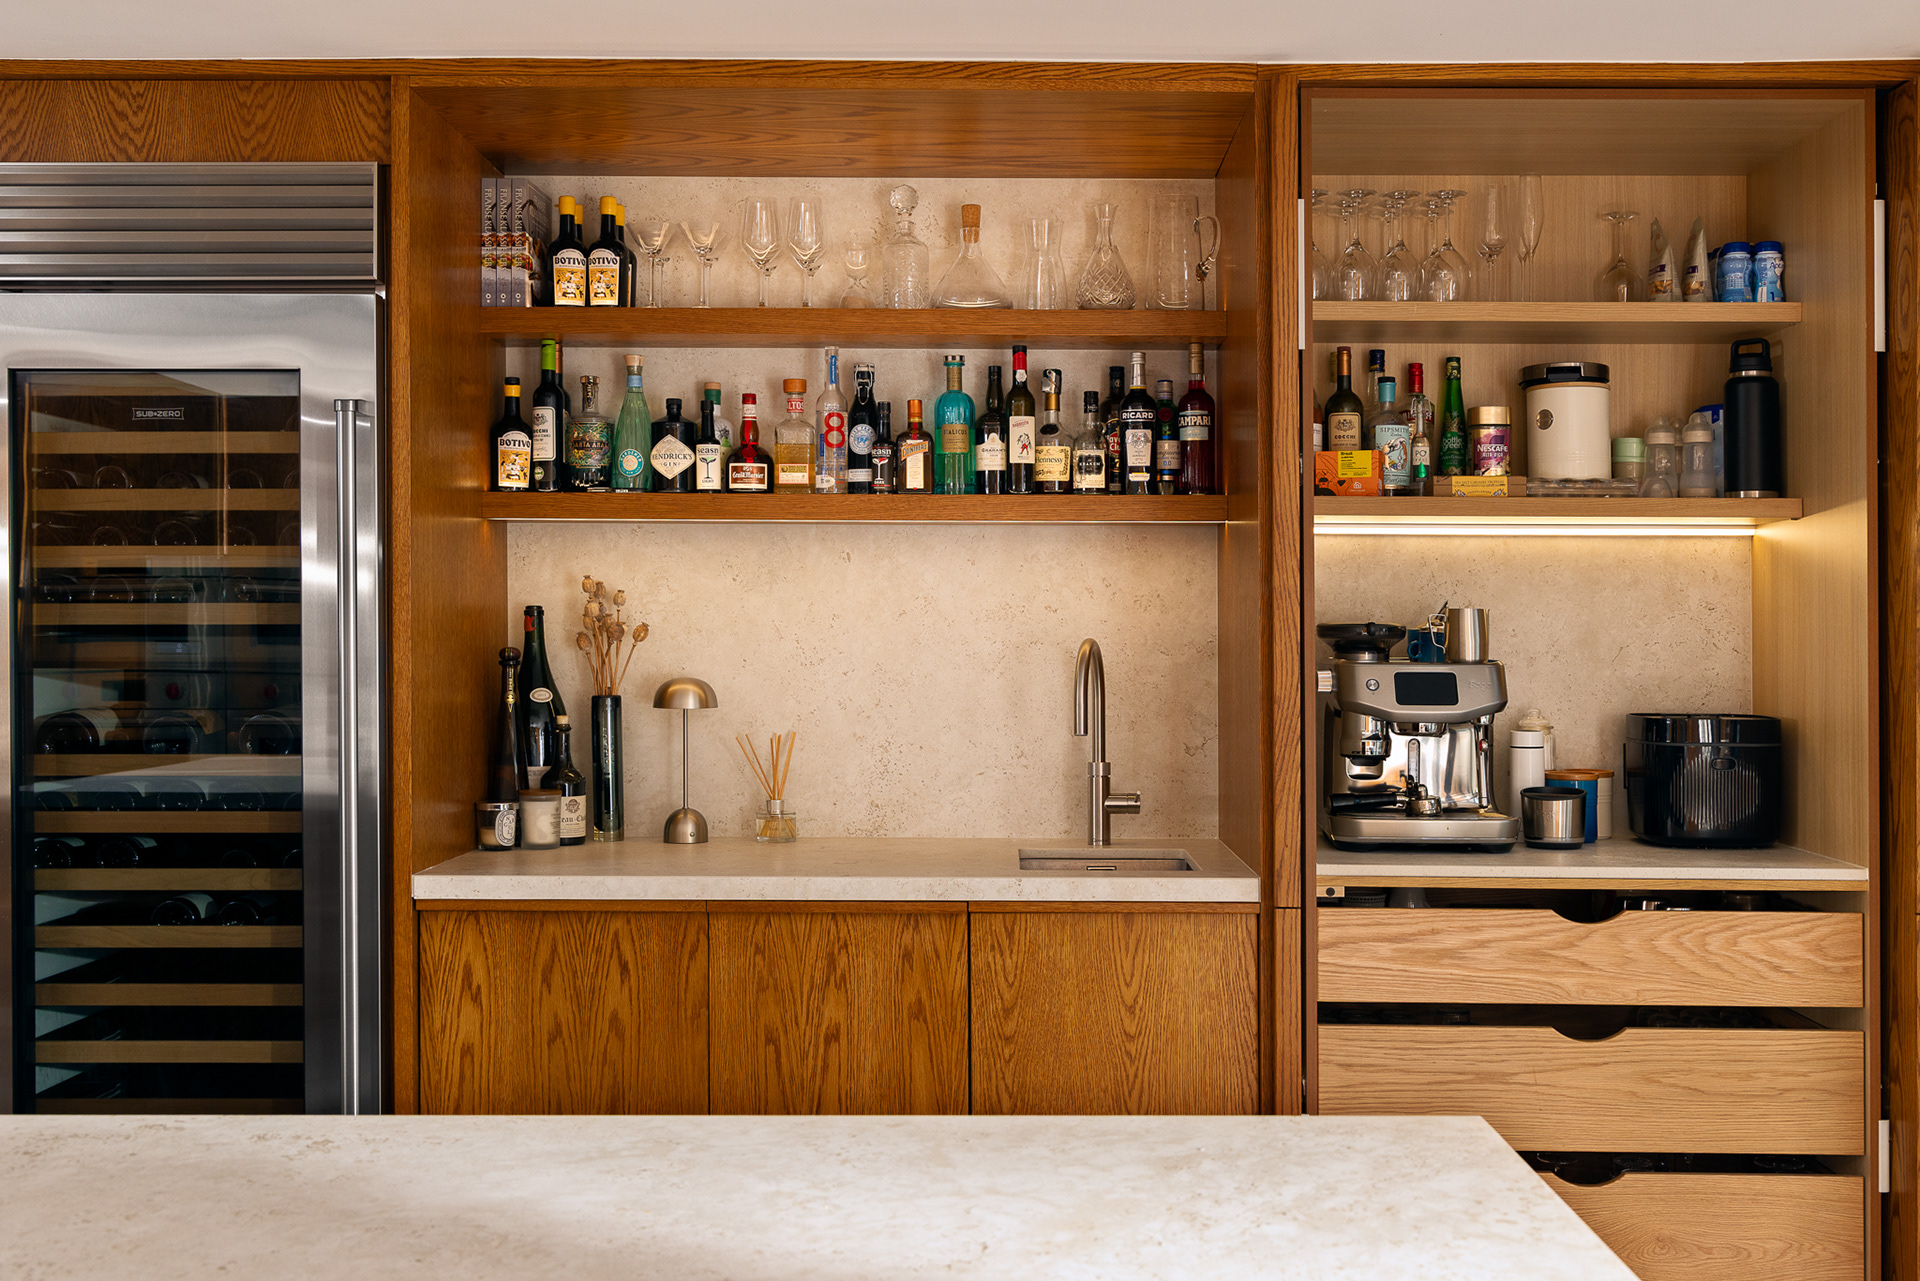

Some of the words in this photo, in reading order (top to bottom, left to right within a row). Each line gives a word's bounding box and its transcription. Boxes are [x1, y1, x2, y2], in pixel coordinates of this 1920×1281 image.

[555, 257, 586, 266] BOTIVO
[589, 257, 618, 265] BOTIVO
[824, 412, 845, 448] 8
[500, 439, 530, 448] BOTIVO
[1443, 436, 1462, 444] bottle
